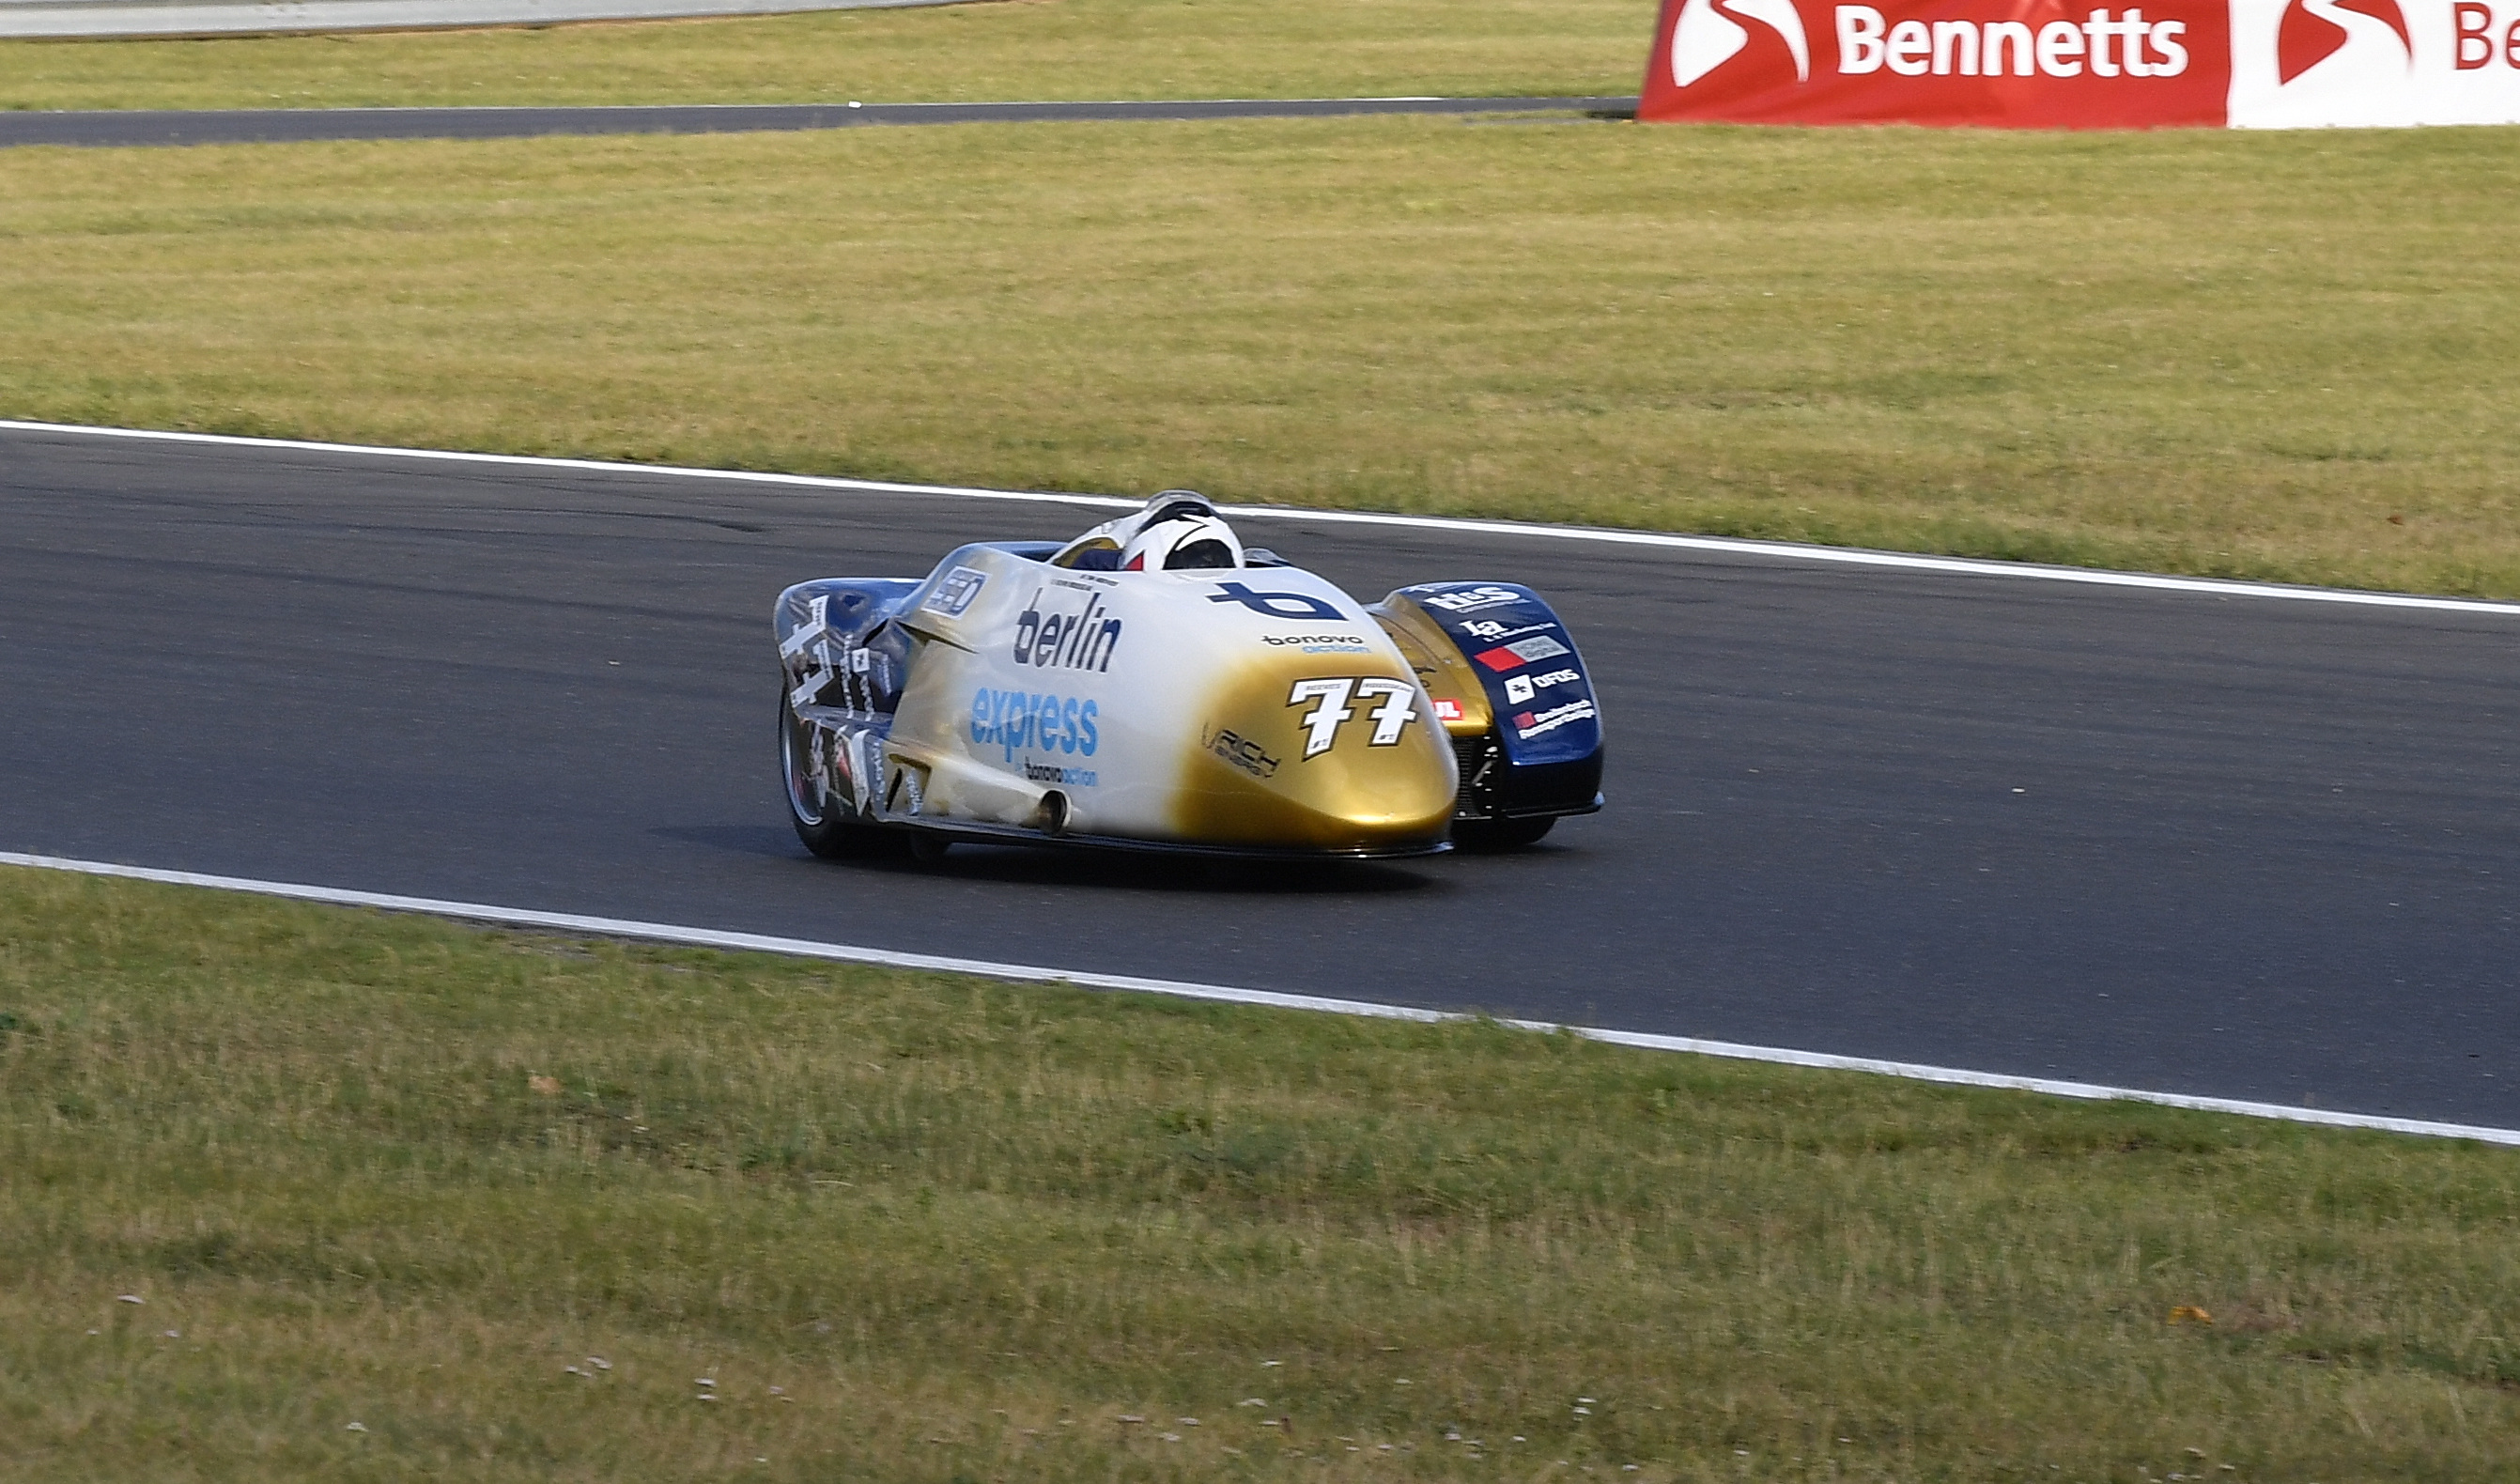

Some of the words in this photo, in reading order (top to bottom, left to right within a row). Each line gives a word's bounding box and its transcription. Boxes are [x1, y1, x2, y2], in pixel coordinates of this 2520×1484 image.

[1835, 4, 2189, 77] Bennetts
[1013, 587, 1121, 672] berlin
[1261, 634, 1365, 646] bonovo
[1303, 645, 1371, 654] action
[971, 687, 1098, 763] express
[1286, 676, 1418, 762] 77
